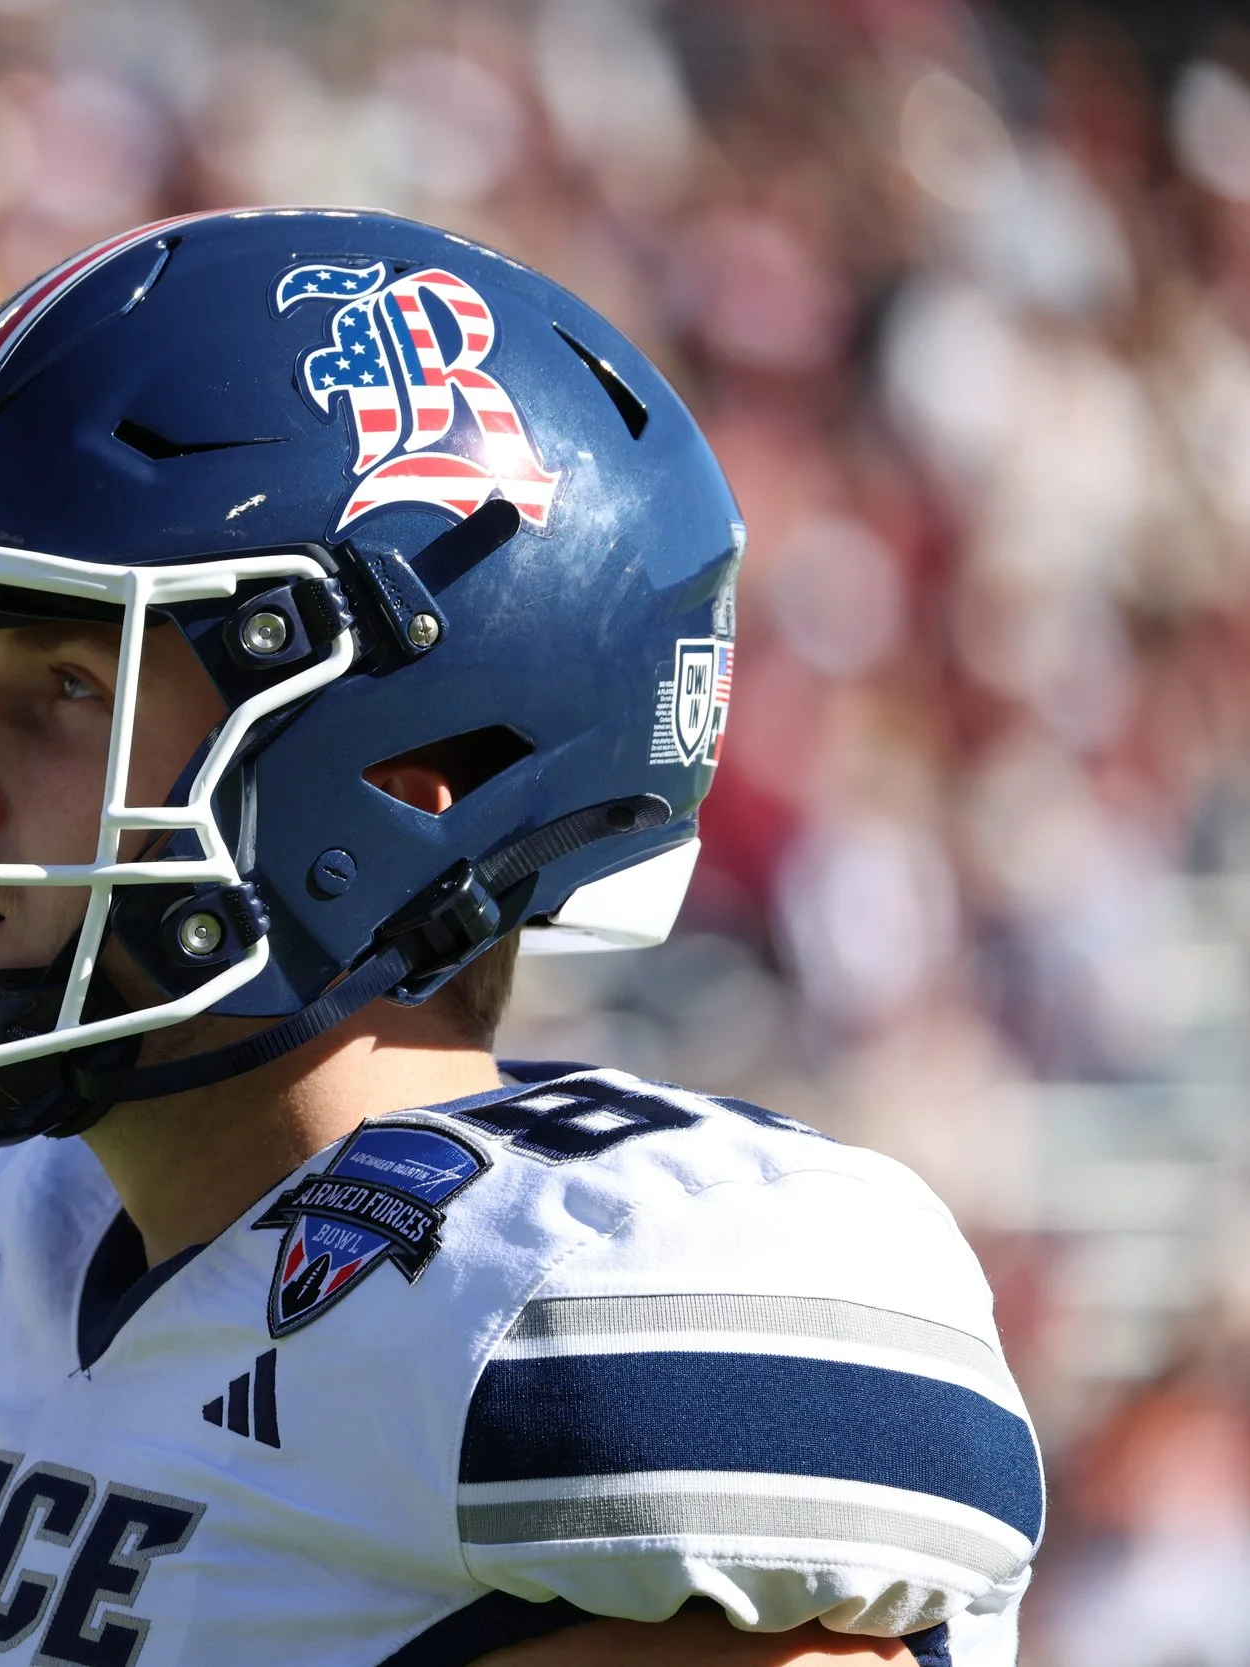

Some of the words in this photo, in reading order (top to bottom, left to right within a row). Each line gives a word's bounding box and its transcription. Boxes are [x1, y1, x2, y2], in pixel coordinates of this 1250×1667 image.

[686, 664, 707, 695] OWL
[688, 698, 701, 728] IN
[293, 1183, 369, 1212] ARMED
[360, 1192, 432, 1242] FORCES
[312, 1224, 363, 1254] BOWL
